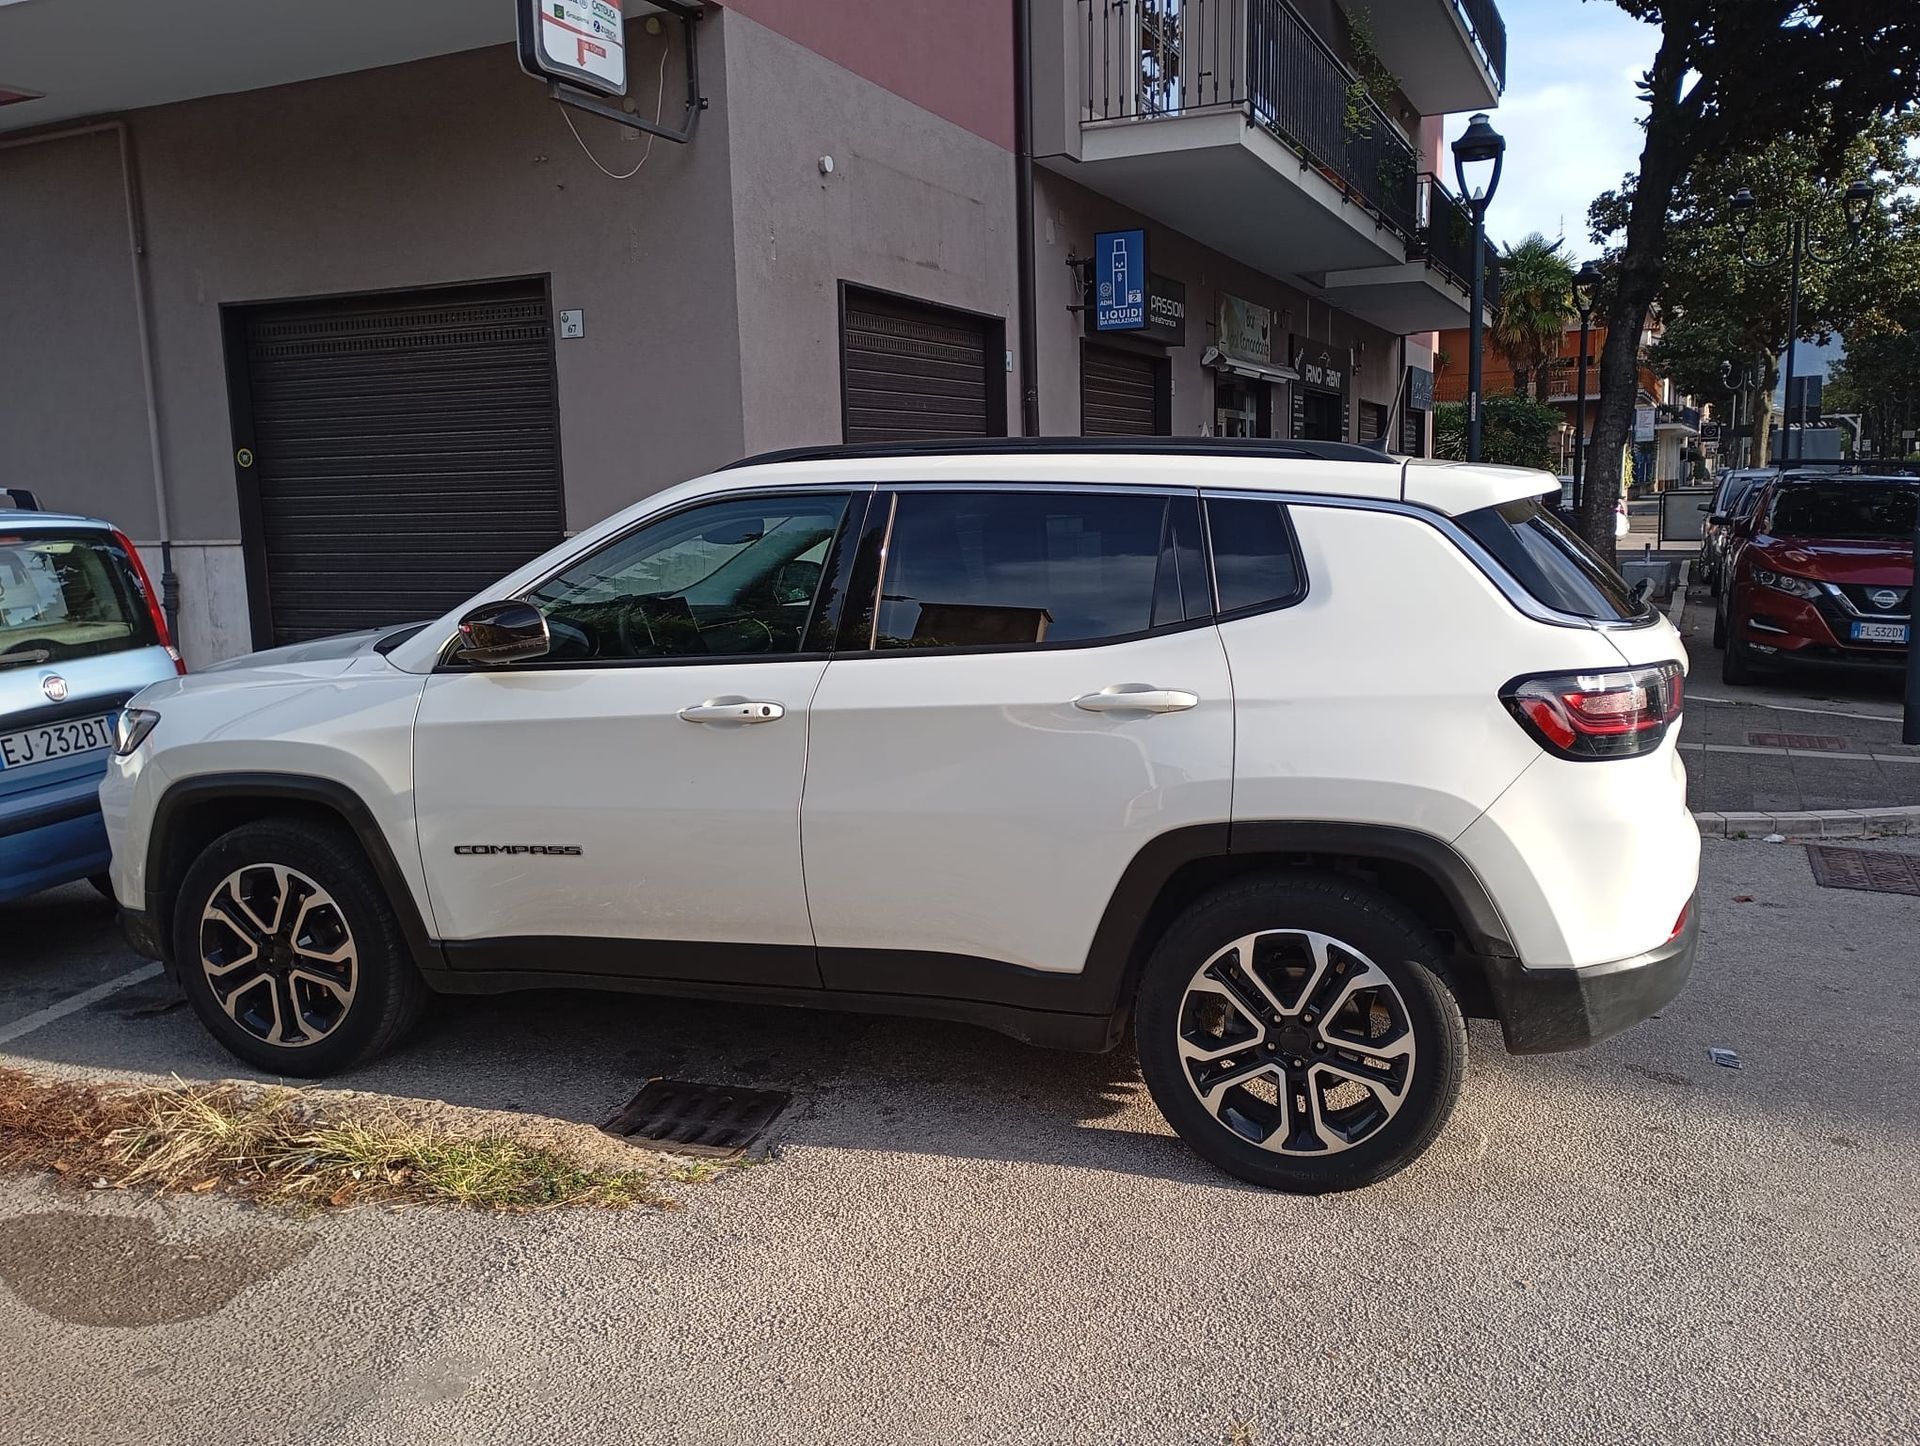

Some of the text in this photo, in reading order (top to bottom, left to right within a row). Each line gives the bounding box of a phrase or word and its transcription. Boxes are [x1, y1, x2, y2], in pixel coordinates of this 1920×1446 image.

[1150, 295, 1185, 319] PASSION
[1100, 308, 1142, 320] LIQUIDI
[568, 324, 576, 333] 67
[1325, 368, 1342, 389] RENT
[454, 845, 583, 856] COMPASS
